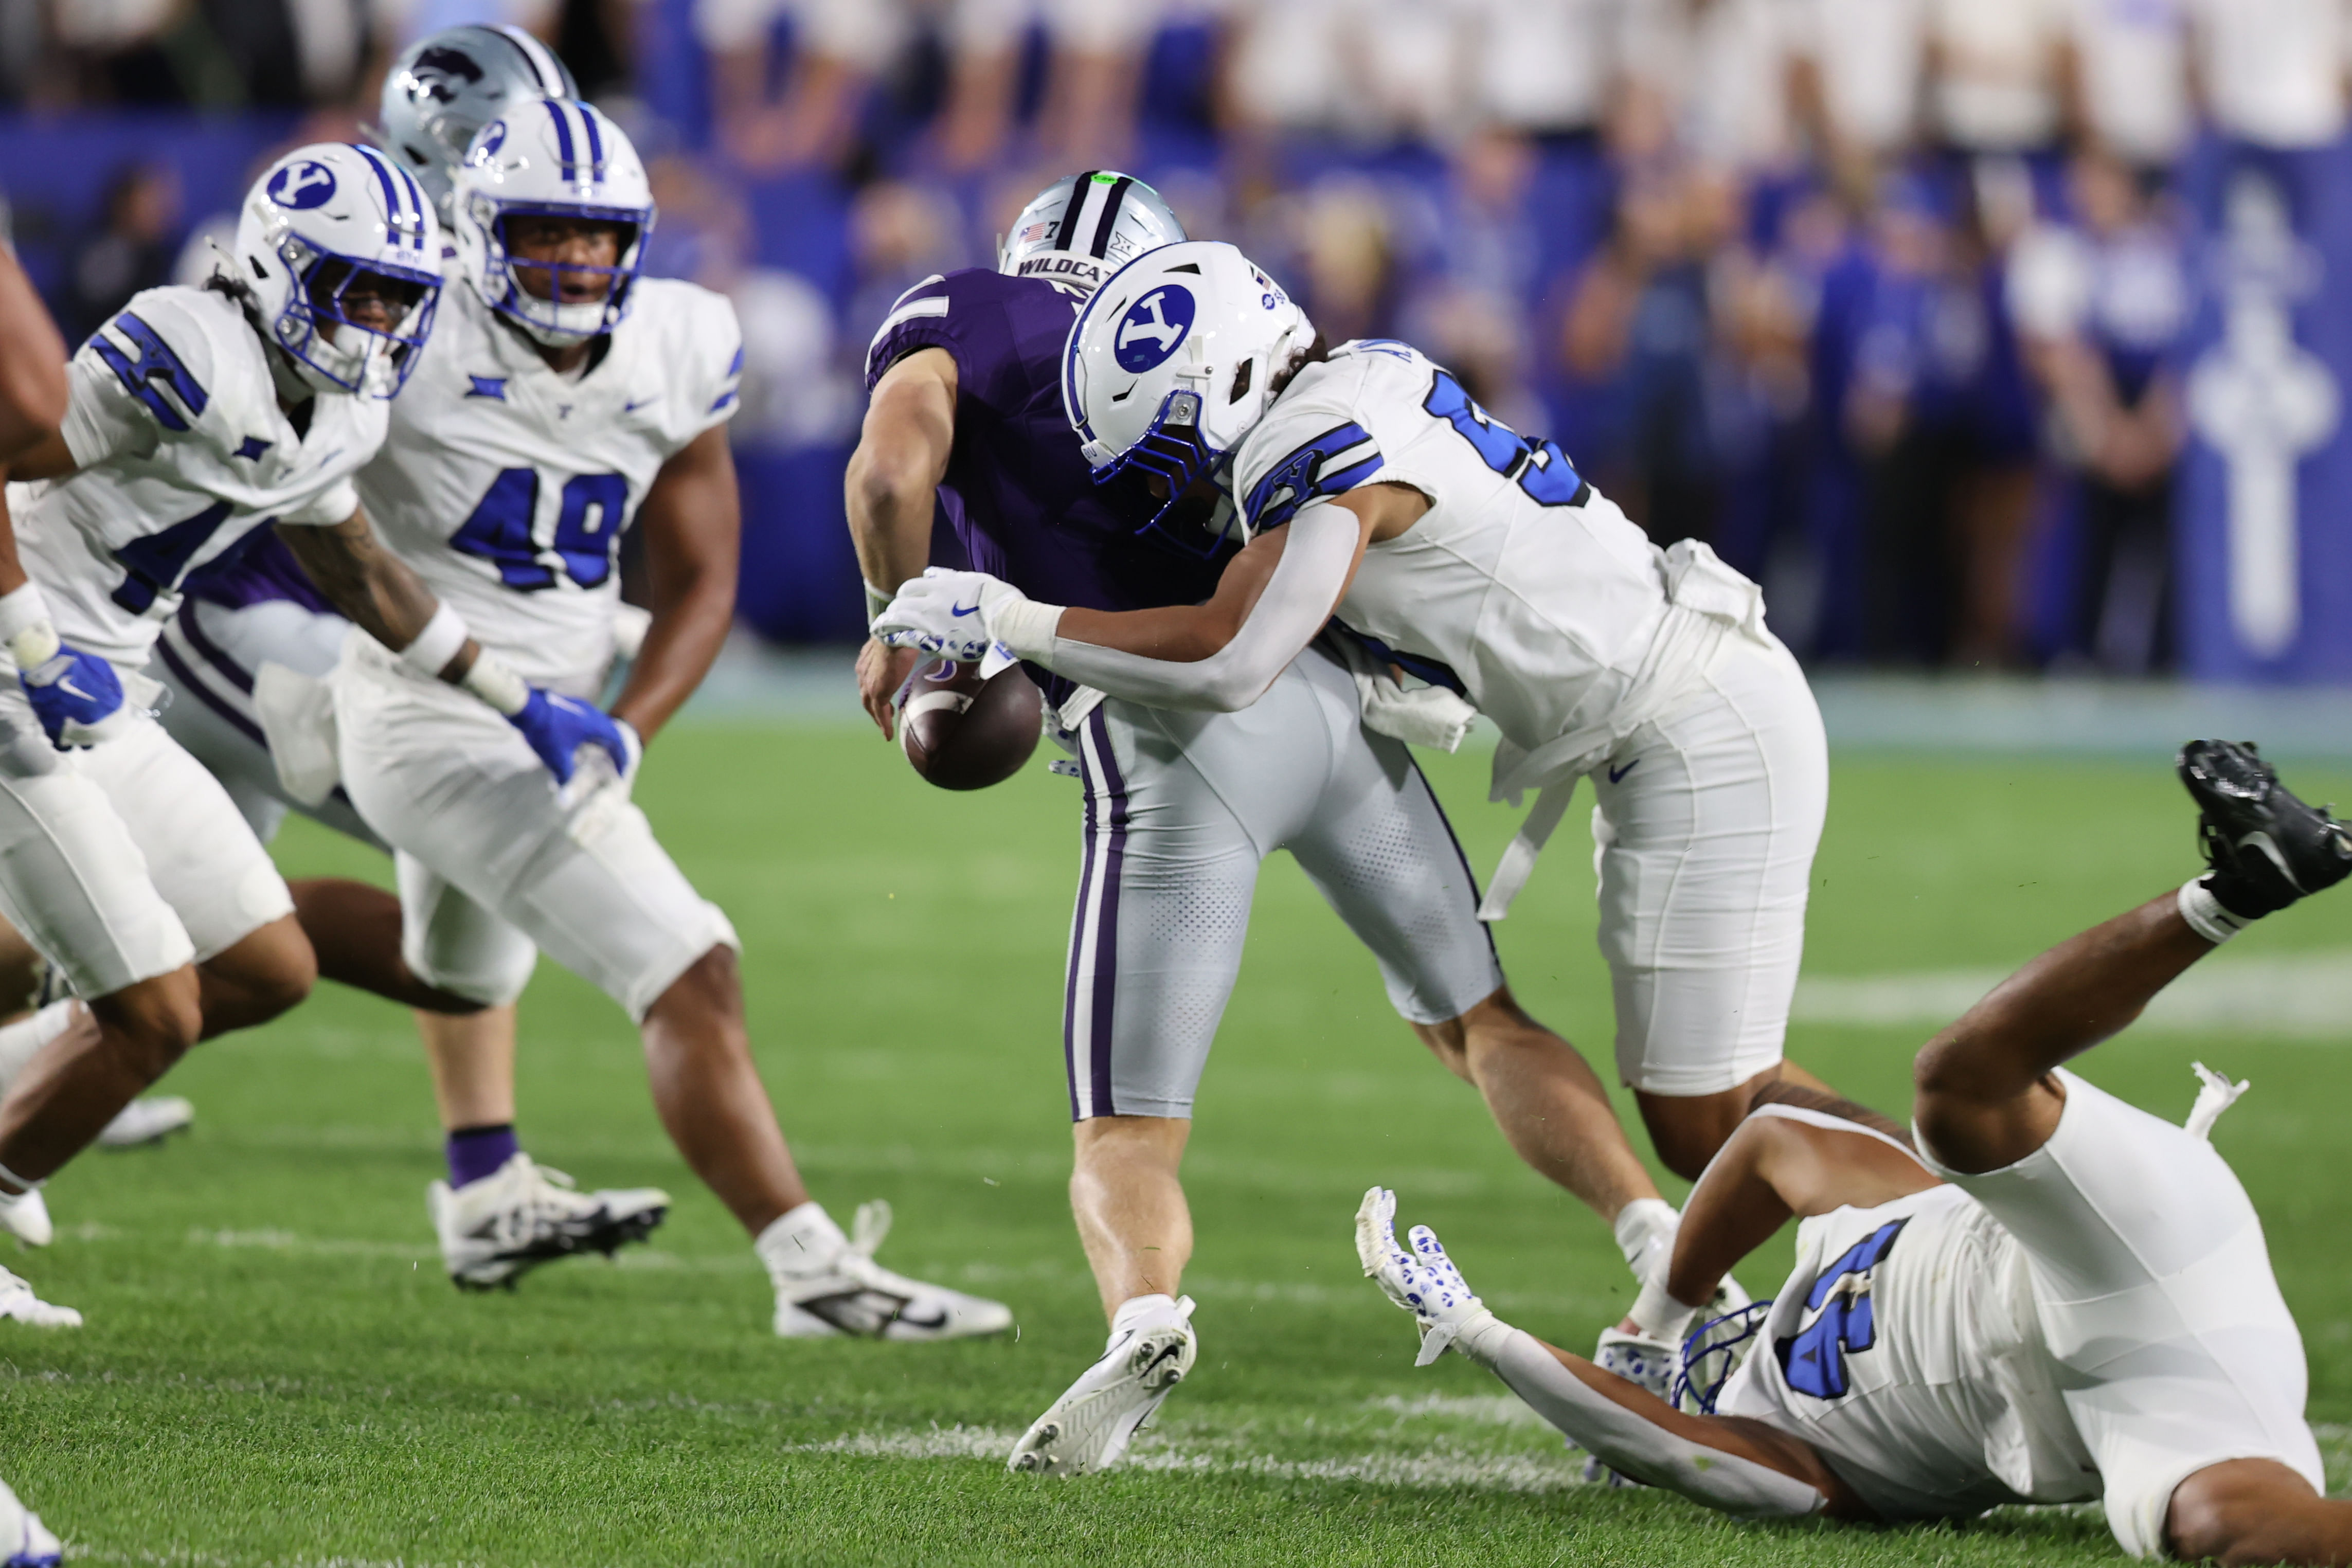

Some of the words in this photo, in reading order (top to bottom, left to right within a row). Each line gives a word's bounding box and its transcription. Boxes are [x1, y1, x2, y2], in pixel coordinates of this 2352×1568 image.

[275, 163, 331, 206] Y
[1045, 221, 1060, 239] 7
[1119, 292, 1184, 352] Y
